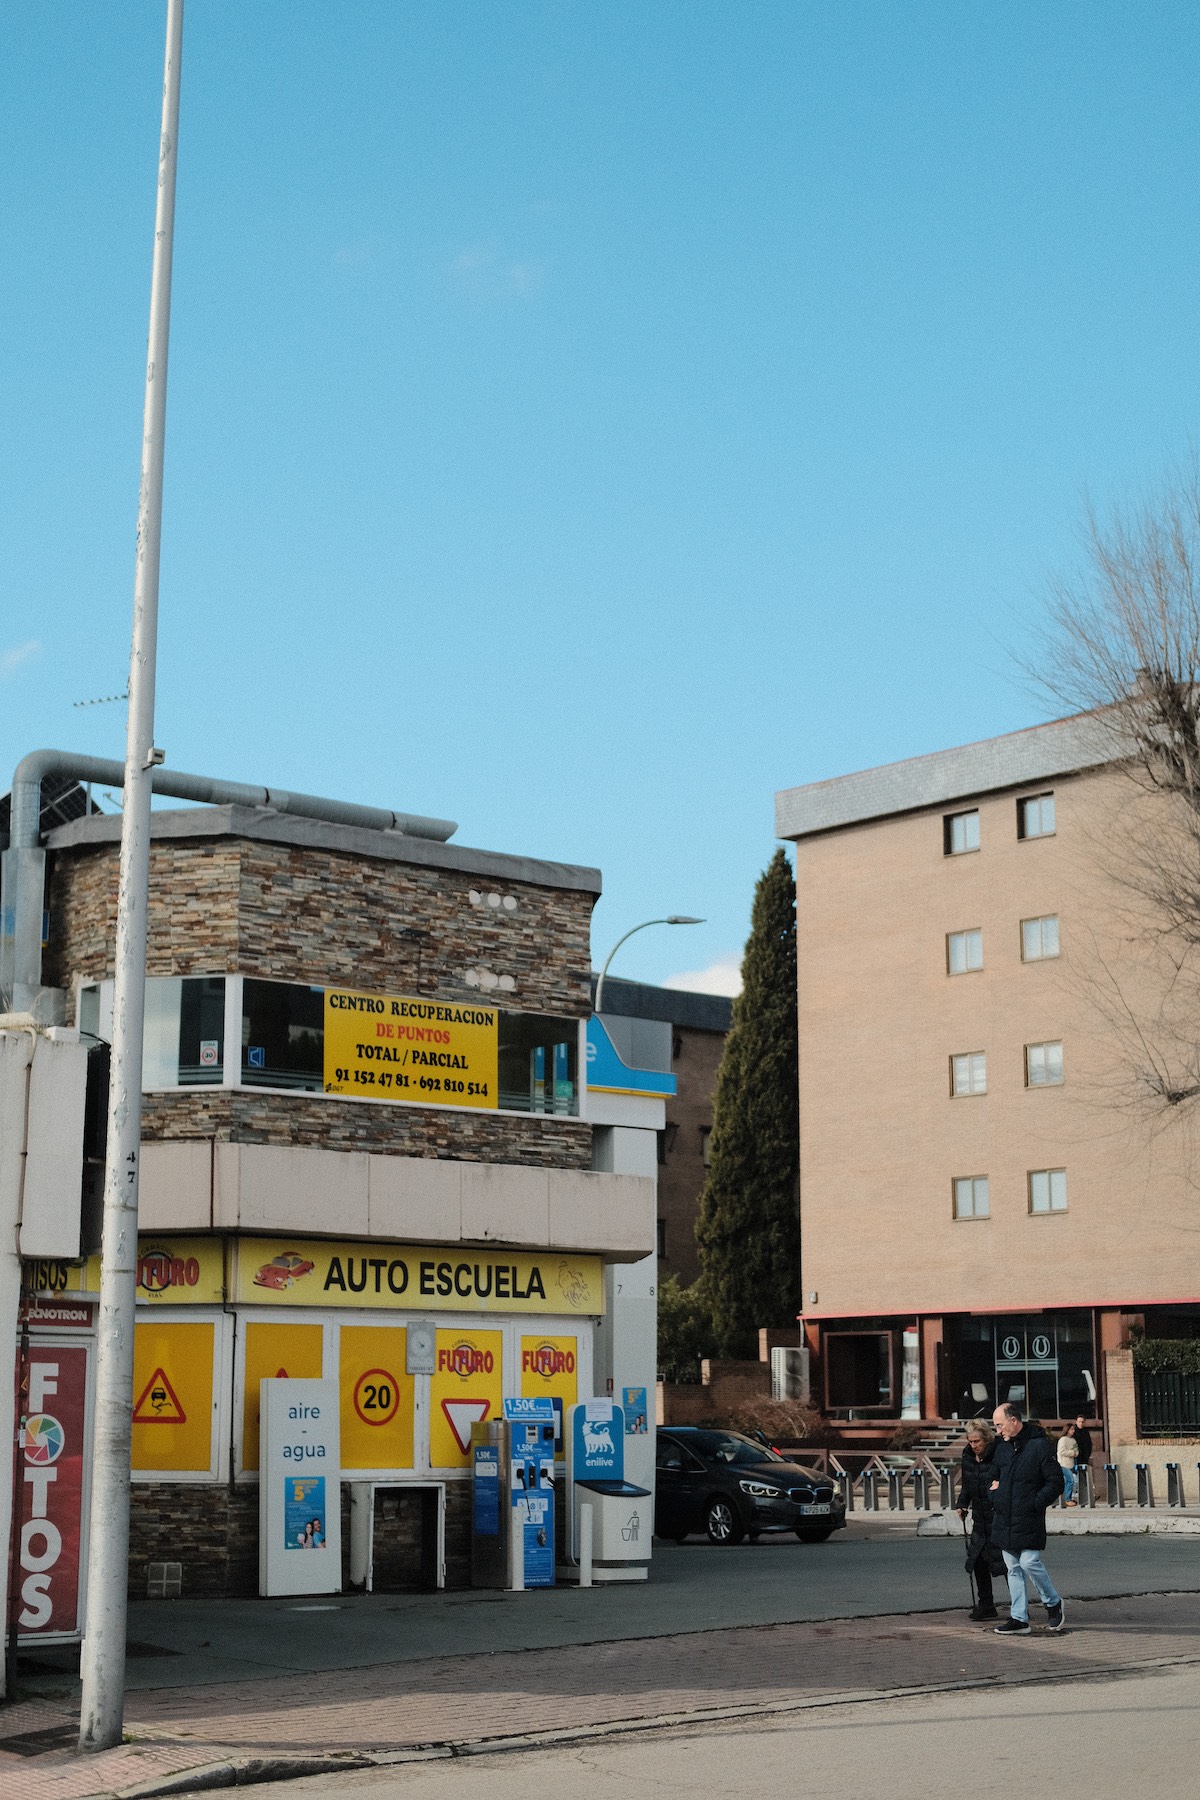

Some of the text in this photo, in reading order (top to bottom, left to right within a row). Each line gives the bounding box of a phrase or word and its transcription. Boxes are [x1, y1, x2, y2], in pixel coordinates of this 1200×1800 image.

[330, 994, 493, 1026] CENTRO RECUPERACION
[376, 1023, 450, 1044] DE PUNTOS
[356, 1044, 400, 1062] TOTAL
[412, 1050, 468, 1069] PARCIAL
[336, 1068, 349, 1082] 91
[354, 1070, 375, 1084] 152
[378, 1072, 393, 1087] 47
[395, 1074, 409, 1087] 81
[420, 1076, 441, 1091] 692
[444, 1078, 464, 1092] 810
[467, 1082, 488, 1096] 514
[323, 1257, 546, 1299] AUTO ESCUELA
[617, 1284, 622, 1294] 7
[650, 1286, 654, 1296] 8
[438, 1349, 494, 1373] FUTURO
[522, 1350, 574, 1373] FUTURO
[364, 1385, 390, 1409] 20
[288, 1403, 320, 1419] aire
[283, 1445, 326, 1462] agua
[586, 1457, 614, 1466] enilive
[294, 1485, 305, 1501] 5
